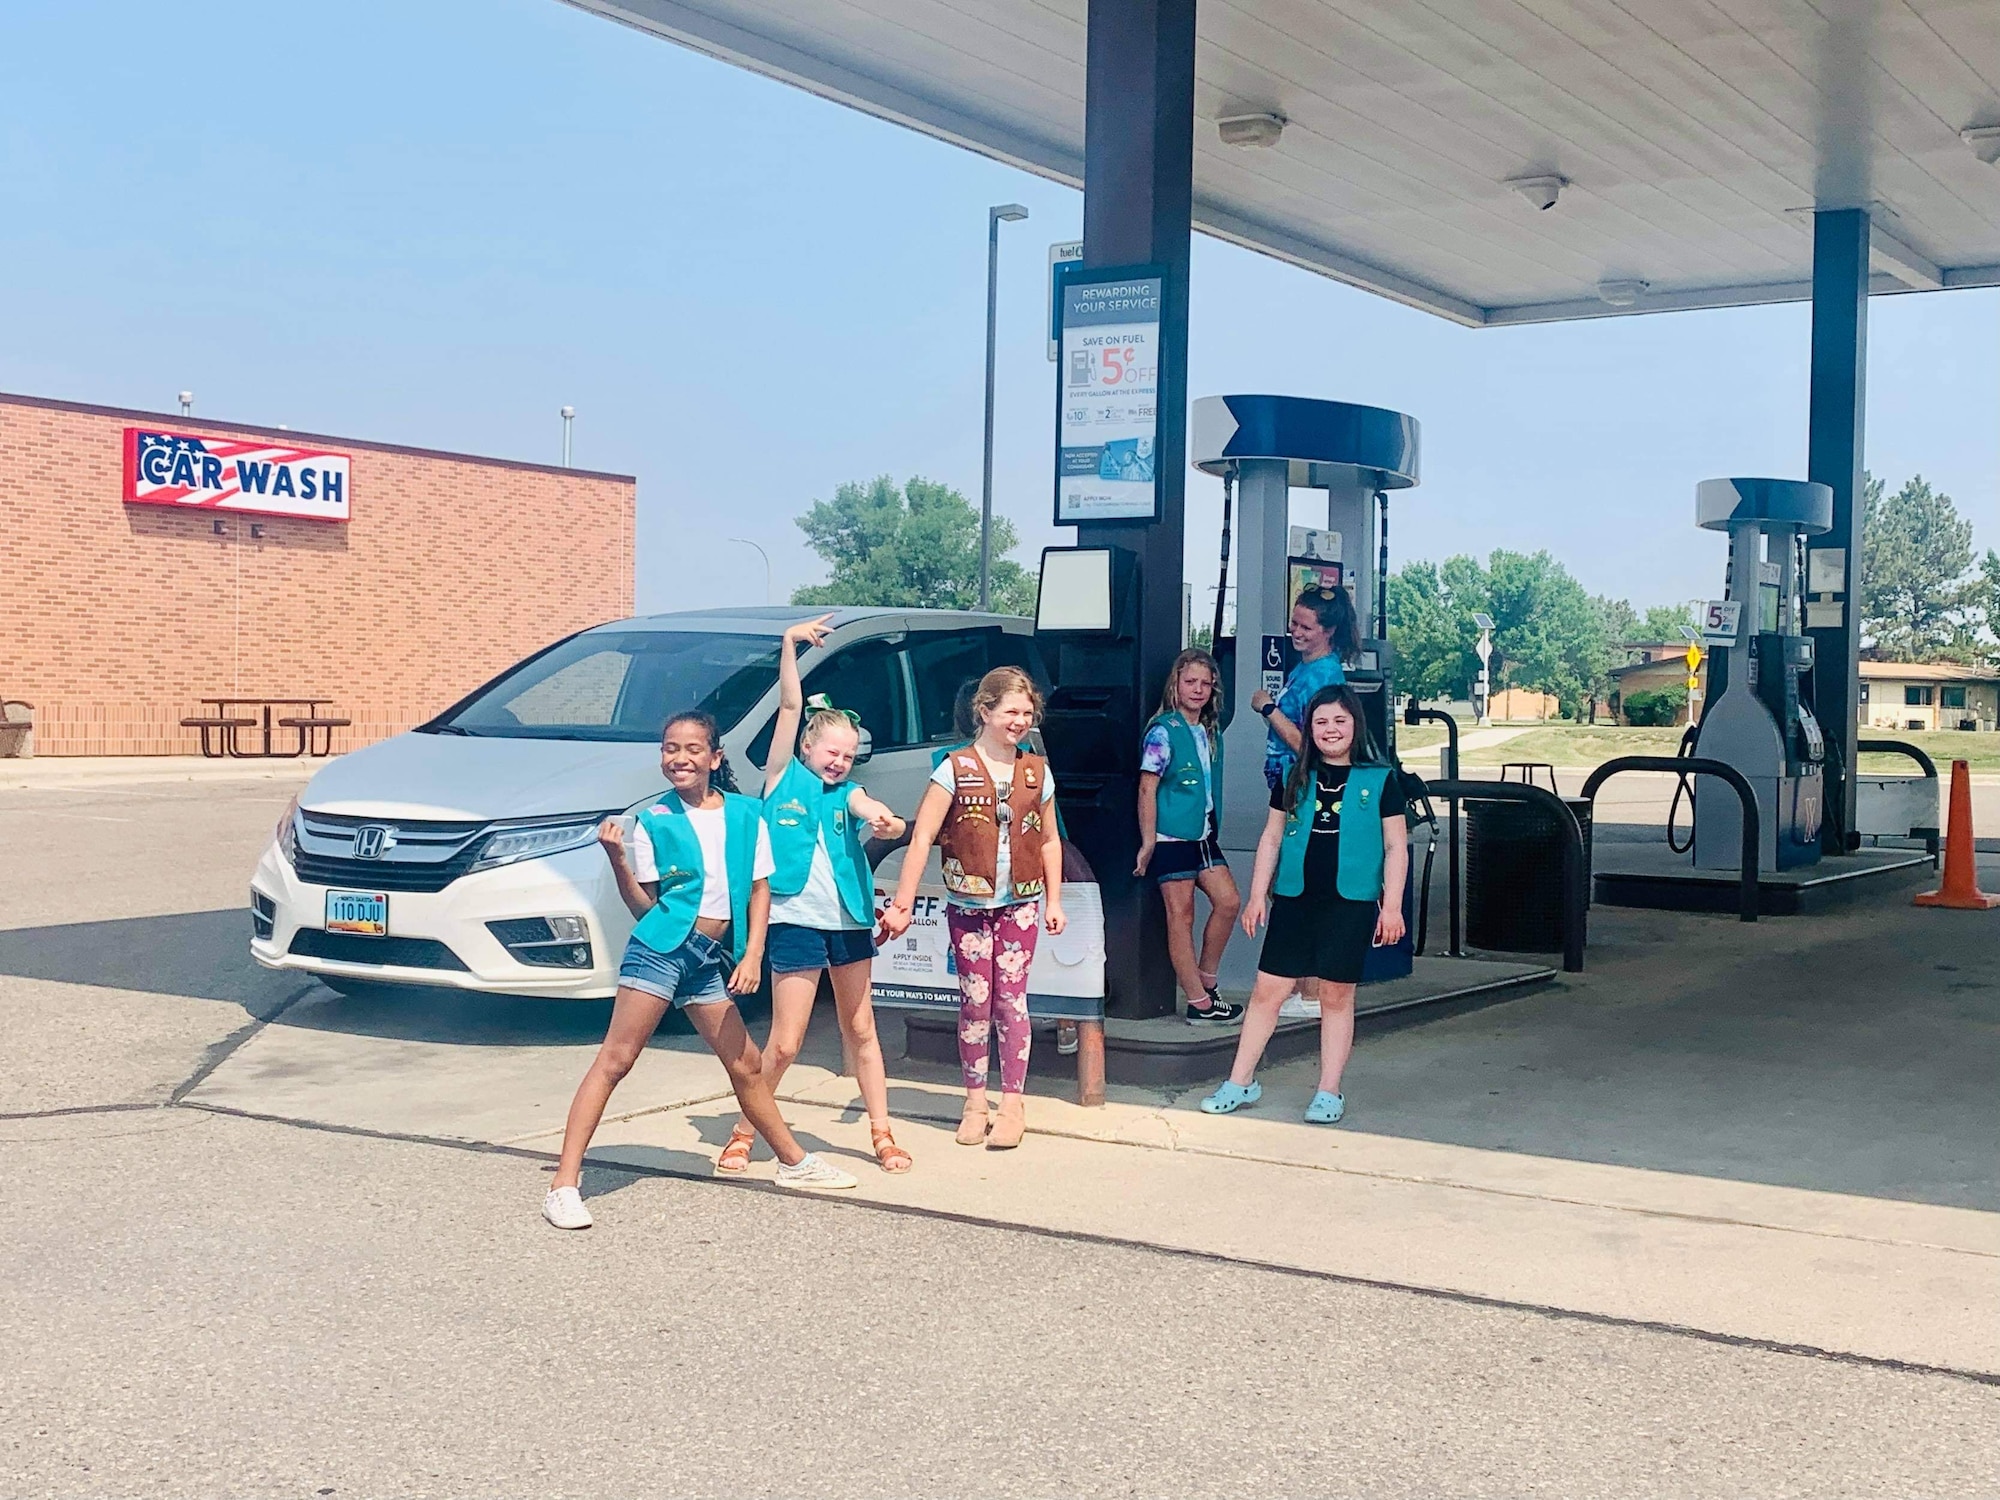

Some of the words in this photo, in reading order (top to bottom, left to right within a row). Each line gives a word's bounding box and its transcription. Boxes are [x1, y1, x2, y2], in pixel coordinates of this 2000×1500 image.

[1082, 285, 1150, 300] REWARDING
[1074, 302, 1105, 313] YOUR
[1109, 298, 1157, 311] SERVICE
[1083, 337, 1104, 346] SAVE
[1105, 337, 1120, 345] ON
[1122, 335, 1145, 343] FUEL
[1124, 367, 1156, 383] OFF
[144, 448, 223, 489] CAR
[237, 459, 342, 502] WASH
[335, 902, 354, 920] 110
[358, 904, 379, 922] DJU
[912, 896, 939, 916] FF
[893, 953, 910, 961] APPLY
[886, 990, 905, 998] YOUR
[905, 991, 923, 1000] WAYS
[934, 994, 951, 1002] SAVE
